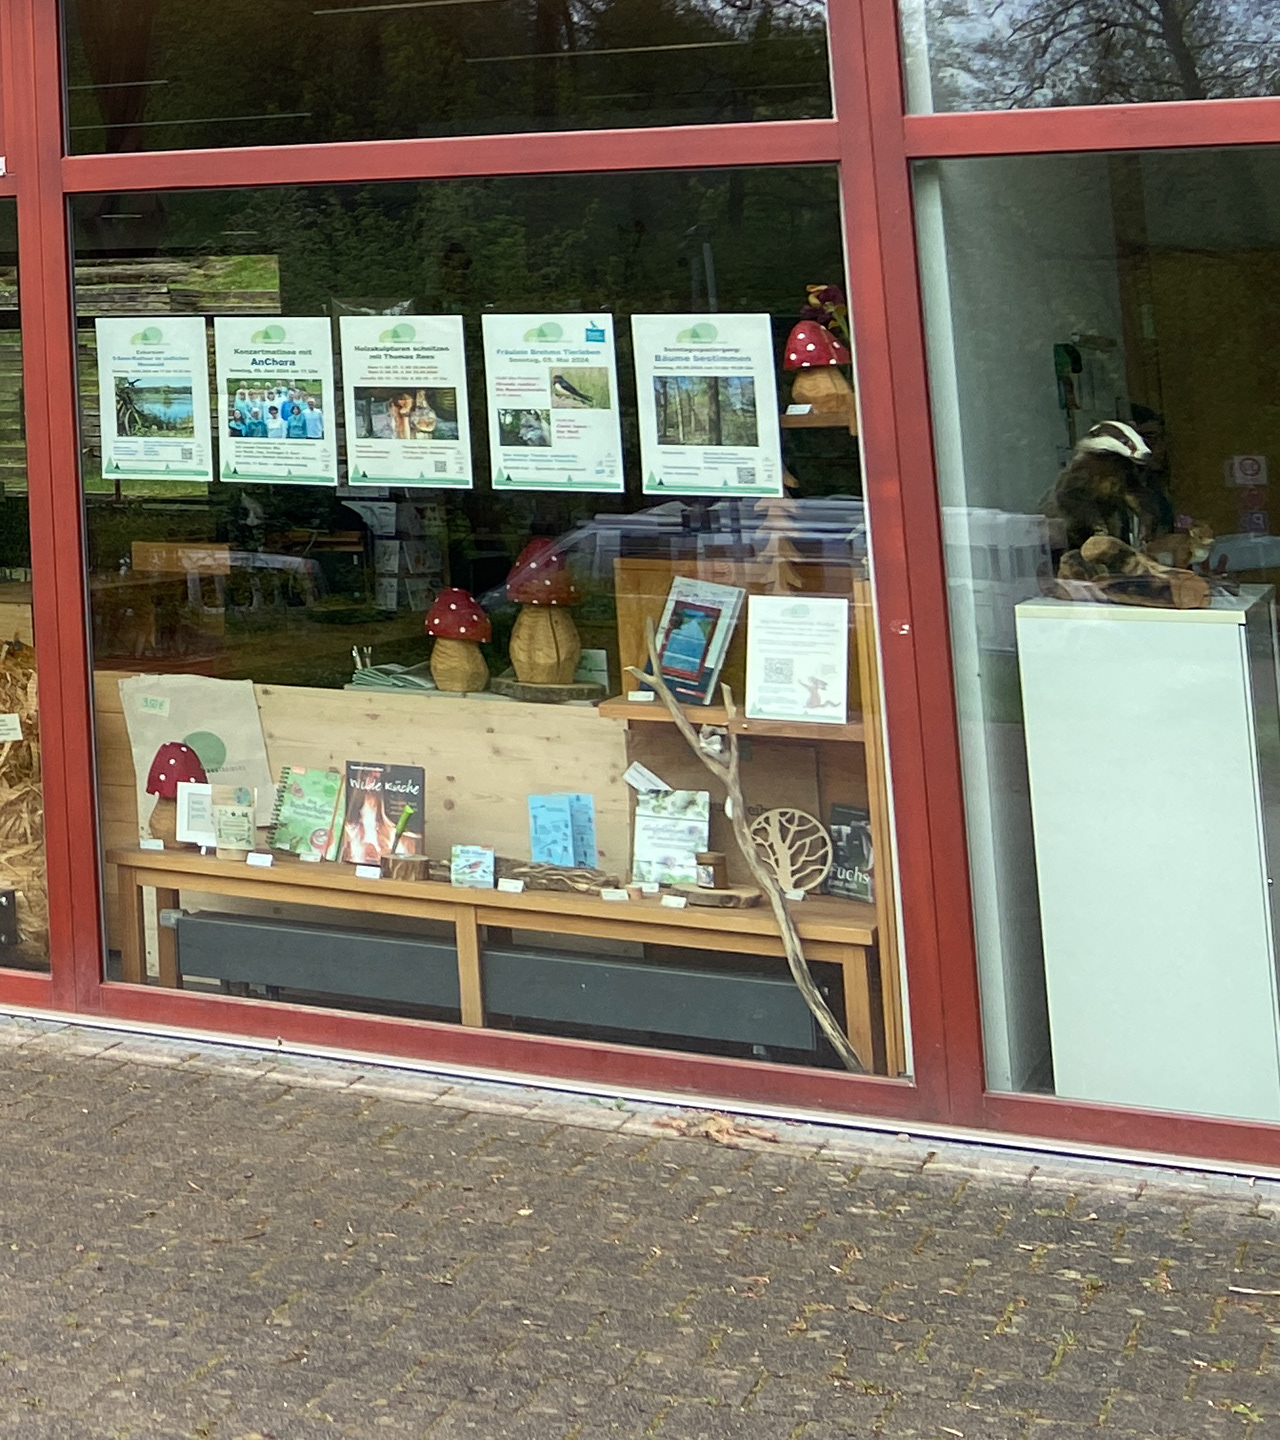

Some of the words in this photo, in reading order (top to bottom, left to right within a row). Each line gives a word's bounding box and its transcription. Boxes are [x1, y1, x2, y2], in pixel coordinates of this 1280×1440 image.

[251, 358, 296, 366] AnChora
[349, 778, 382, 791] Wilde
[384, 779, 420, 796] Küche
[828, 863, 870, 883] Fuchs
